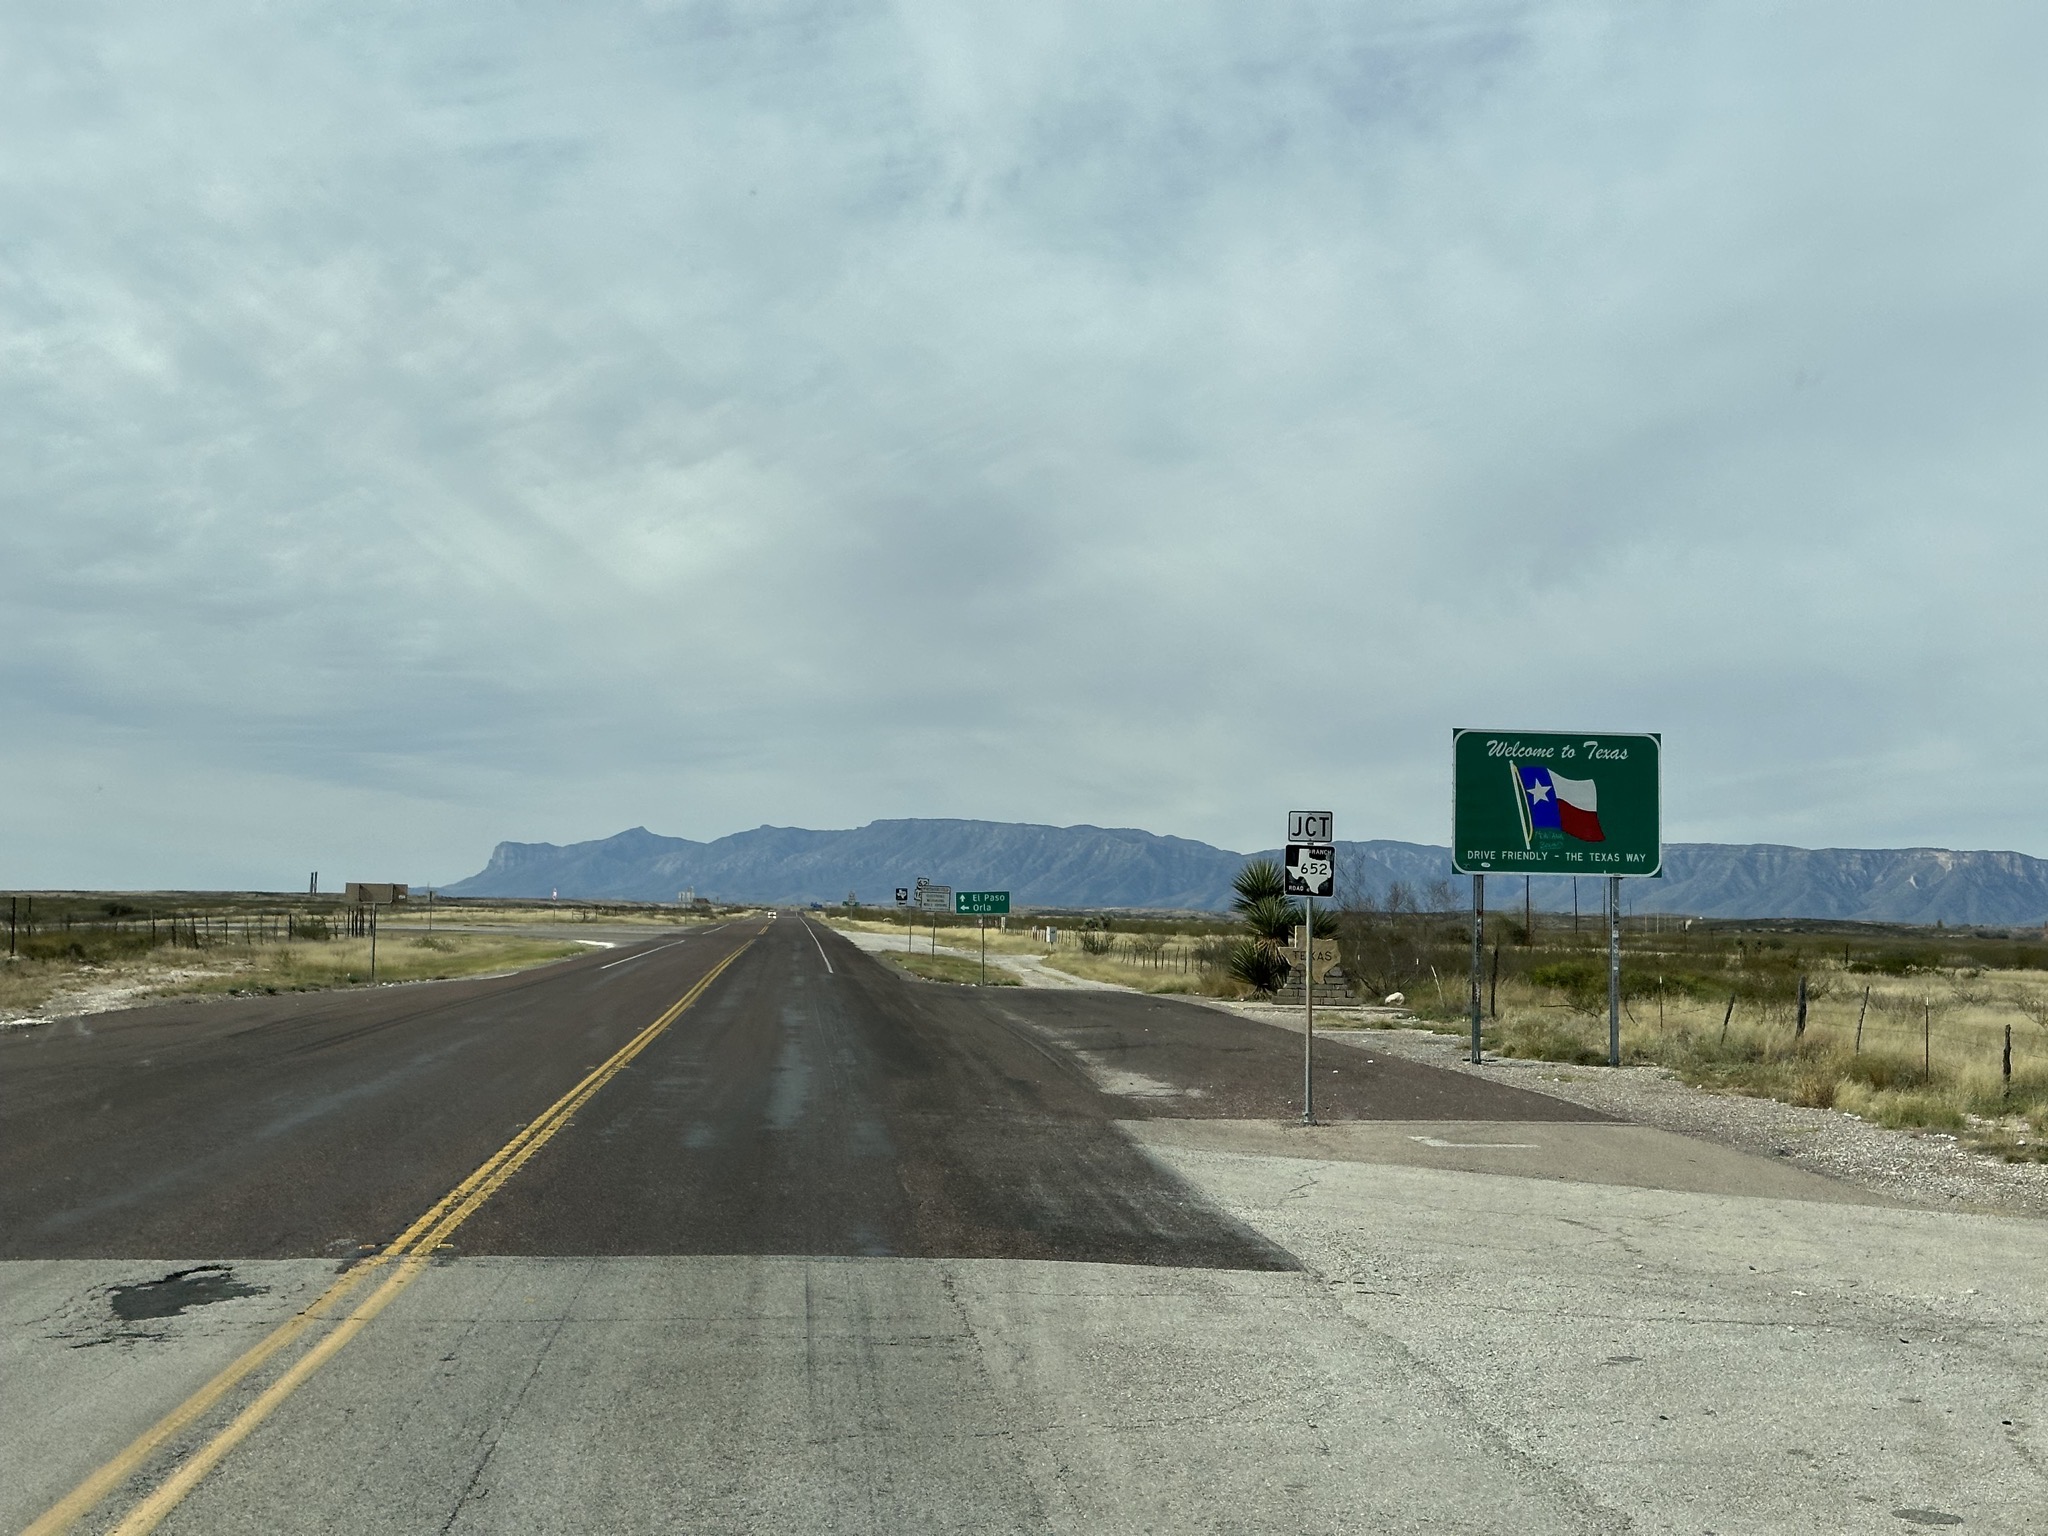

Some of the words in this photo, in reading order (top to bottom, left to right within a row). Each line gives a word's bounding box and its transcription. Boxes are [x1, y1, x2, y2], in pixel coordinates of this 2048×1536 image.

[1486, 739, 1555, 758] Welcome
[1561, 744, 1576, 759] to
[1583, 740, 1629, 760] Texas
[1291, 816, 1330, 837] JCT
[1467, 850, 1496, 860] DRIVE
[1501, 851, 1548, 861] FRIENDLY
[1565, 852, 1583, 862] THE
[1589, 852, 1620, 862] TEXAS
[1626, 853, 1647, 863] WAY
[1300, 863, 1328, 875] 652
[972, 894, 980, 902] El
[984, 894, 1006, 902] Paso
[972, 903, 992, 912] Orla
